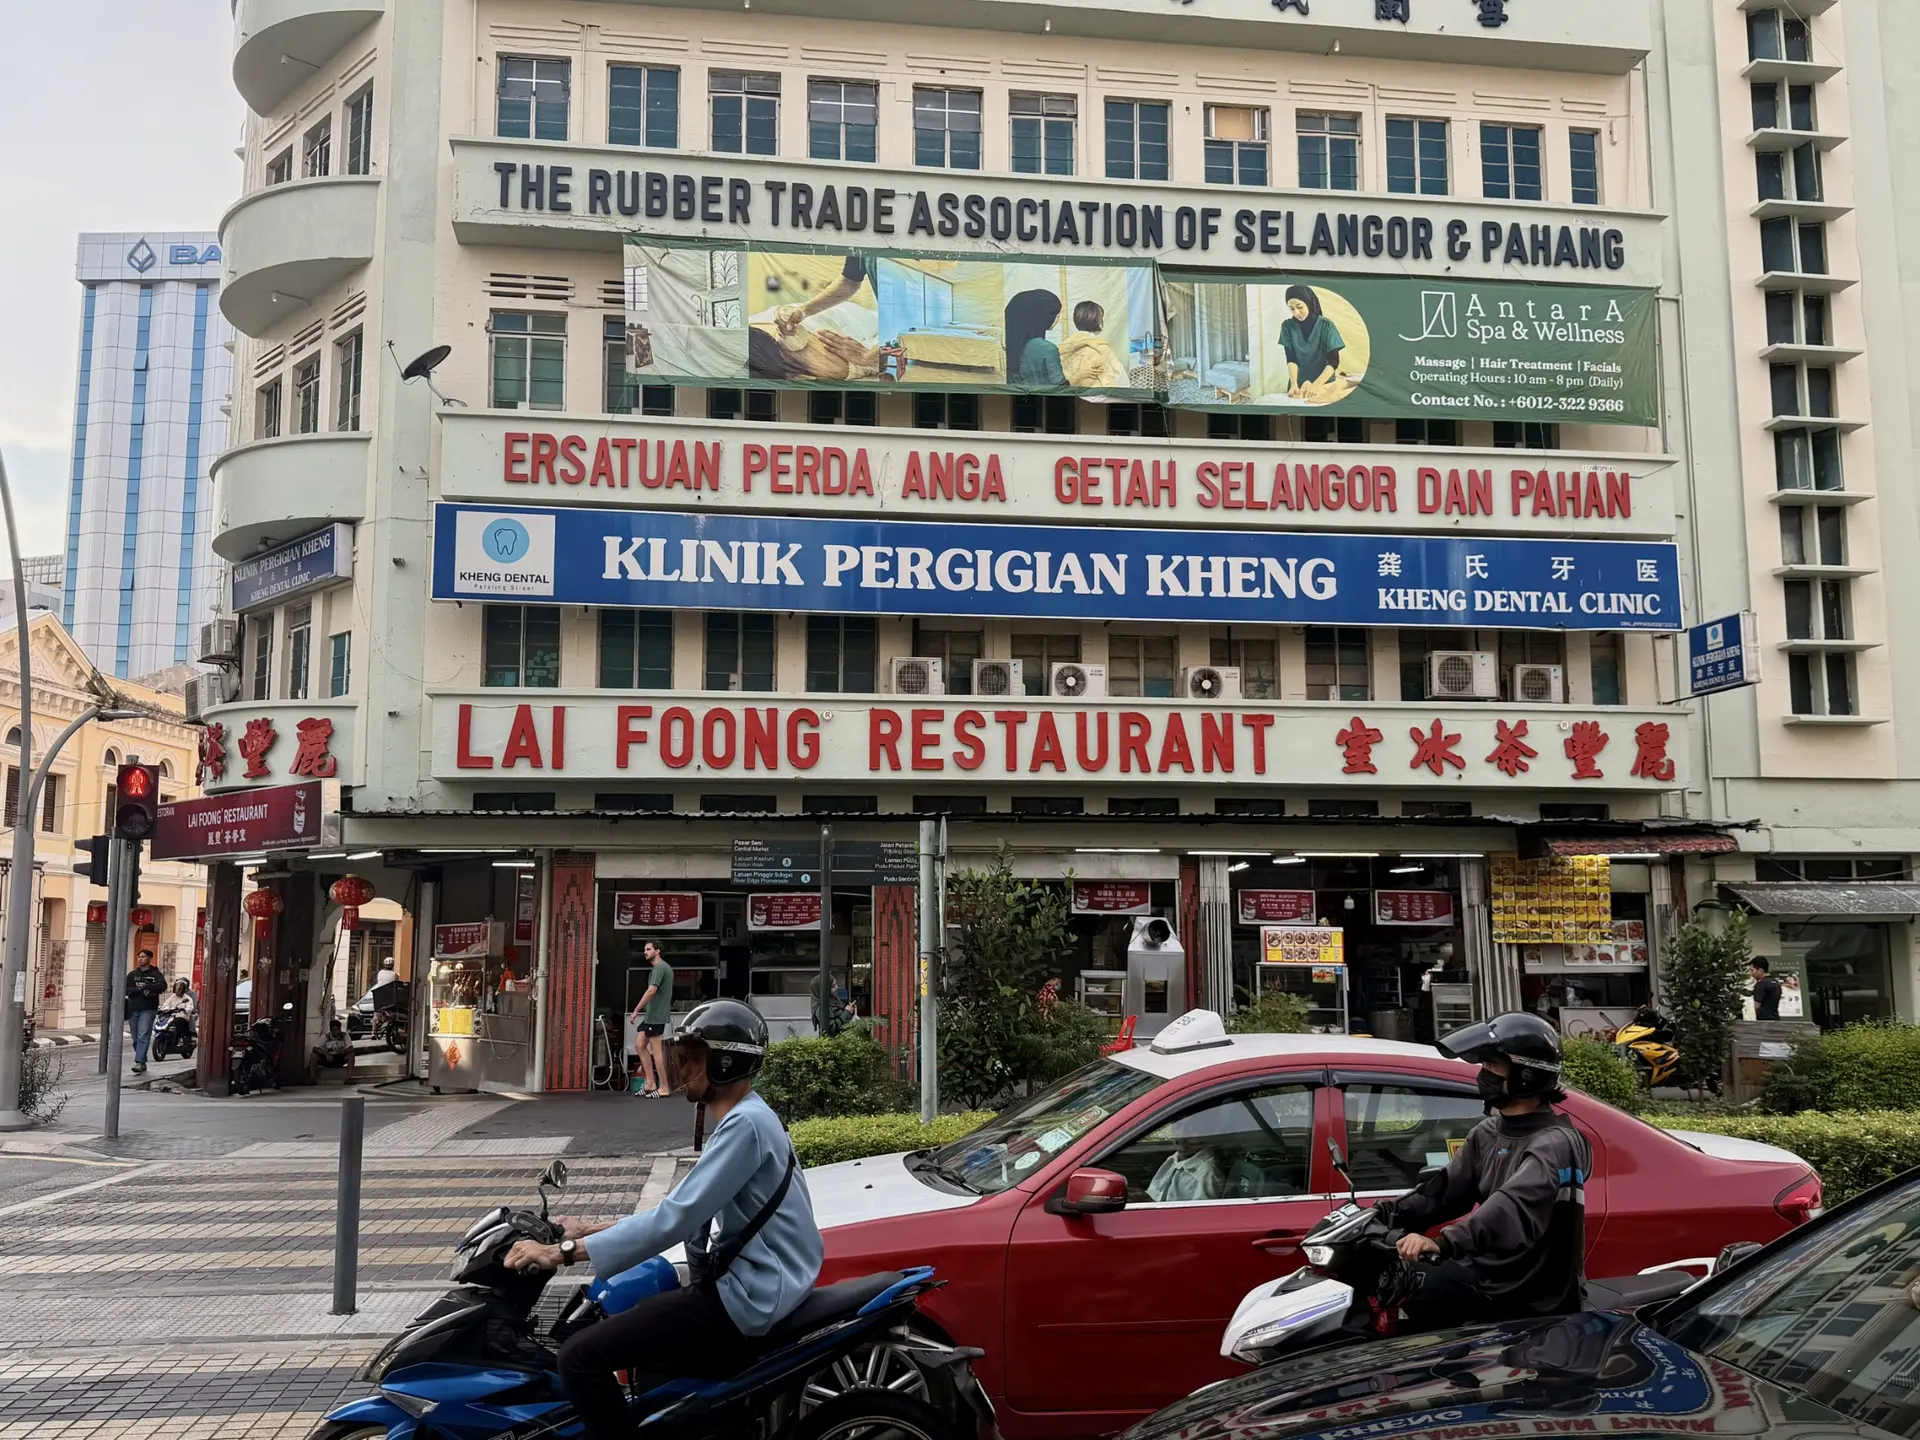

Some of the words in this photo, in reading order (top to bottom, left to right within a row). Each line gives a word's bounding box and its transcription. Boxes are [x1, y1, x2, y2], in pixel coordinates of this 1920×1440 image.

[494, 162, 572, 212] THE
[589, 168, 751, 224] RUBBER
[764, 180, 895, 233] TRADE
[908, 191, 1164, 250] ASSOCIATION
[1175, 206, 1222, 250] OF
[1234, 208, 1433, 260] SELANGOR
[1447, 219, 1471, 261] &
[1483, 221, 1625, 270] PAHANG
[1466, 319, 1507, 344] Spa
[1511, 320, 1529, 340] &
[1532, 321, 1625, 344] Wellness
[1414, 356, 1466, 370] Massage
[1480, 358, 1508, 369] Hair
[1509, 359, 1573, 371] Treatment
[1583, 361, 1622, 374] Facials
[1410, 371, 1468, 384] Operating
[1513, 373, 1527, 384] 10
[1528, 376, 1547, 385] am
[1556, 375, 1564, 385] 8
[1565, 378, 1584, 388] pm
[1588, 377, 1624, 390] (Daily)
[1411, 393, 1470, 407] Contact
[1508, 395, 1586, 410] +6012-322
[1588, 398, 1625, 412] 9366
[504, 432, 720, 491] ERSATUAN
[743, 443, 873, 496] PERDA
[901, 450, 1007, 502] ANGA
[1054, 456, 1176, 508] GETAH
[1196, 460, 1398, 512] SELANGOR
[1417, 466, 1493, 515] DAN
[1511, 469, 1631, 518] PAHAN
[234, 561, 259, 584] KLINIK
[302, 533, 331, 557] KHENG
[602, 535, 805, 586] KLINIK
[822, 544, 1128, 597] PERGIGIAN
[1146, 554, 1338, 601] KHENG
[459, 571, 501, 582] KHENG
[504, 573, 550, 584] DENTAL
[474, 583, 506, 591] Petaling
[1377, 588, 1467, 611] KHENG
[1474, 590, 1573, 613] DENTAL
[1579, 592, 1661, 615] CLINIC
[456, 703, 565, 770] LAI
[616, 705, 821, 770] FOONG
[868, 707, 1275, 773] RESTAURANT
[157, 806, 175, 818] ESTORAN
[188, 813, 198, 828] LAI
[199, 810, 221, 826] FOONG
[224, 804, 268, 823] RESTAURANT
